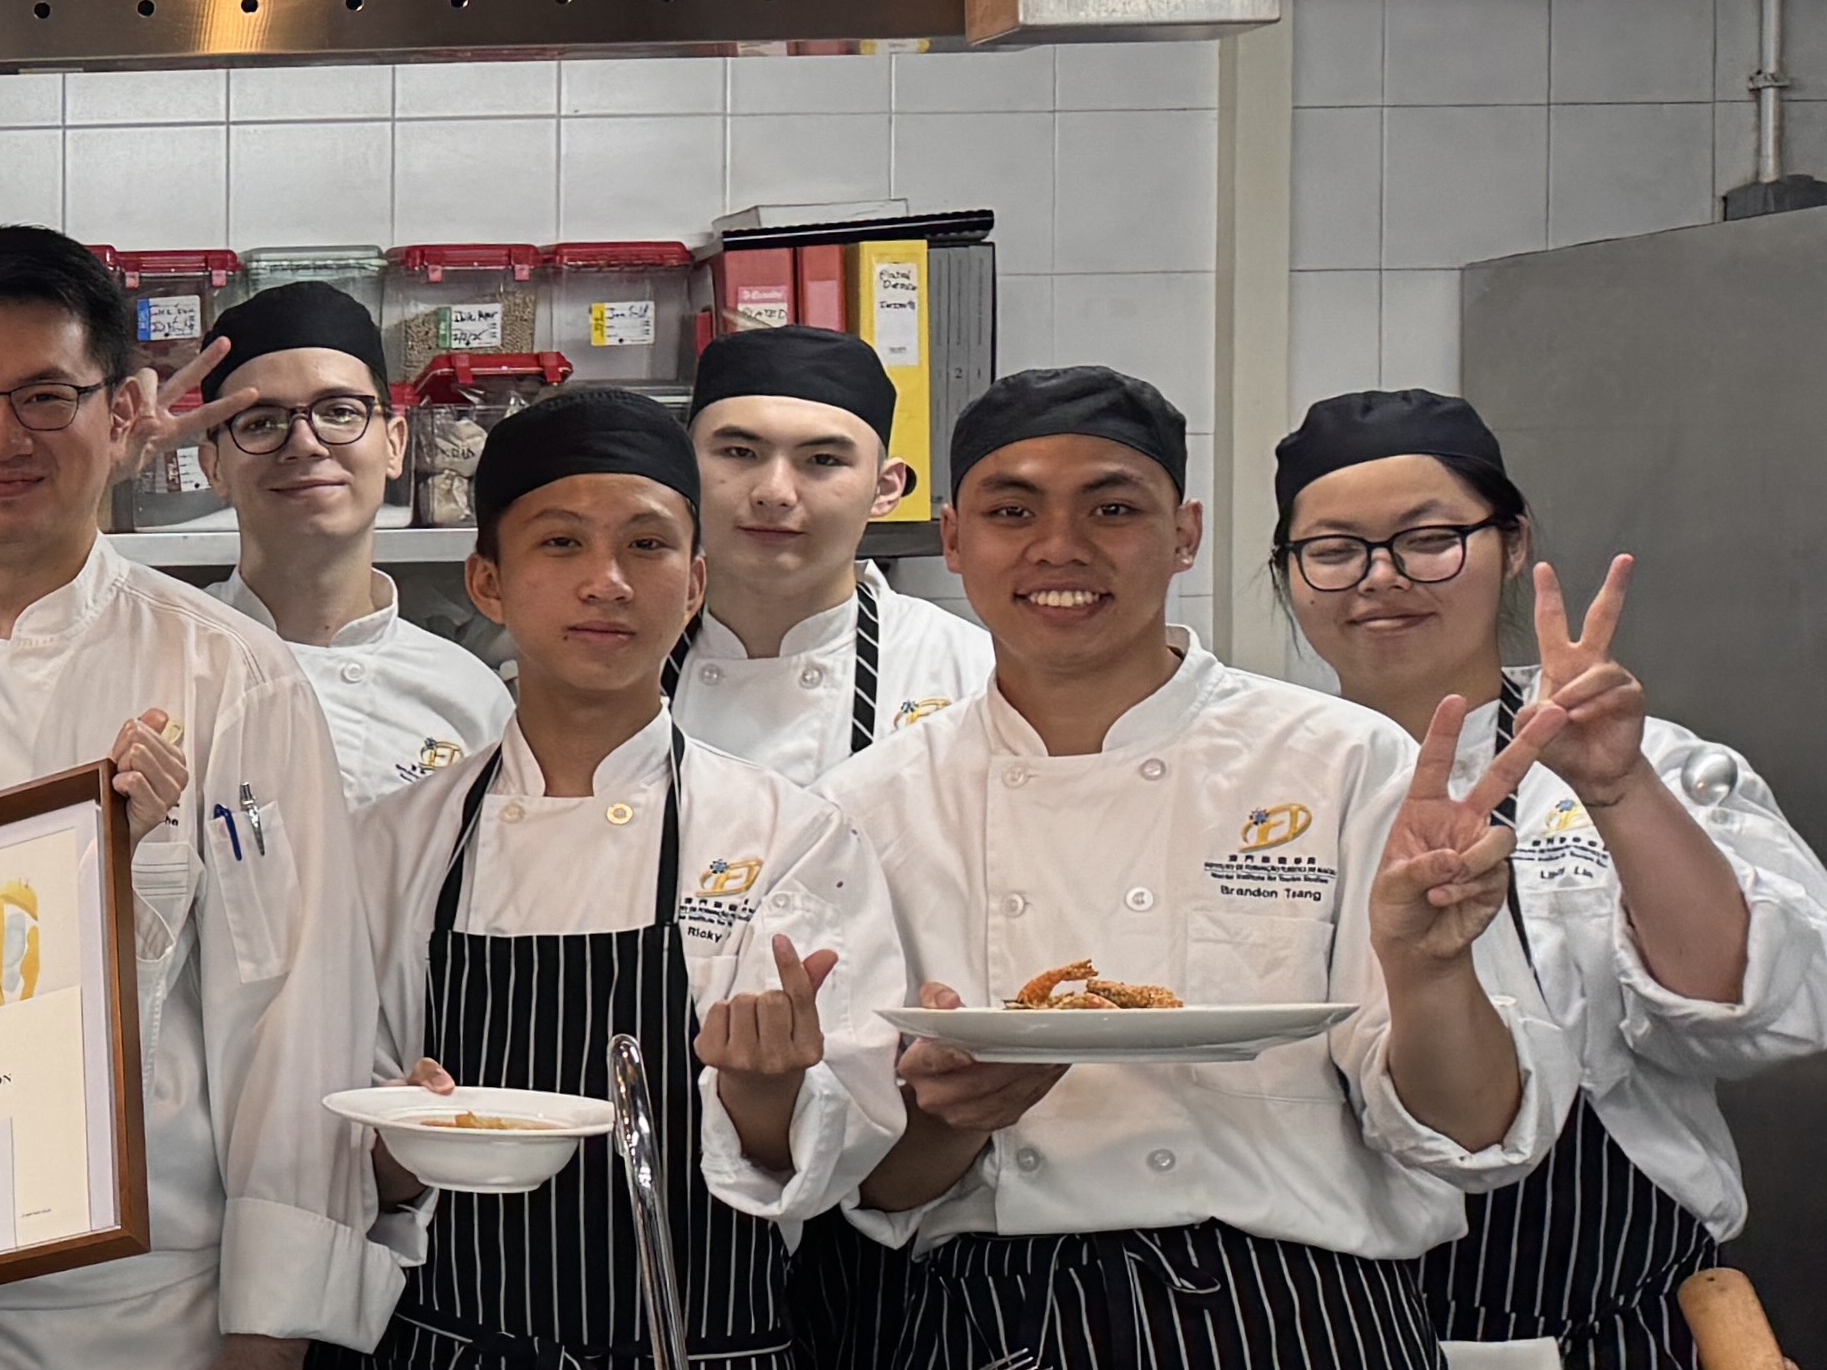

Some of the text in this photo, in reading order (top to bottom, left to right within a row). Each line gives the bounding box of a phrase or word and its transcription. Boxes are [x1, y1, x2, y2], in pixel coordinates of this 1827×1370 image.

[1220, 884, 1322, 902] Brandon Tsang
[688, 926, 723, 943] Ricky
